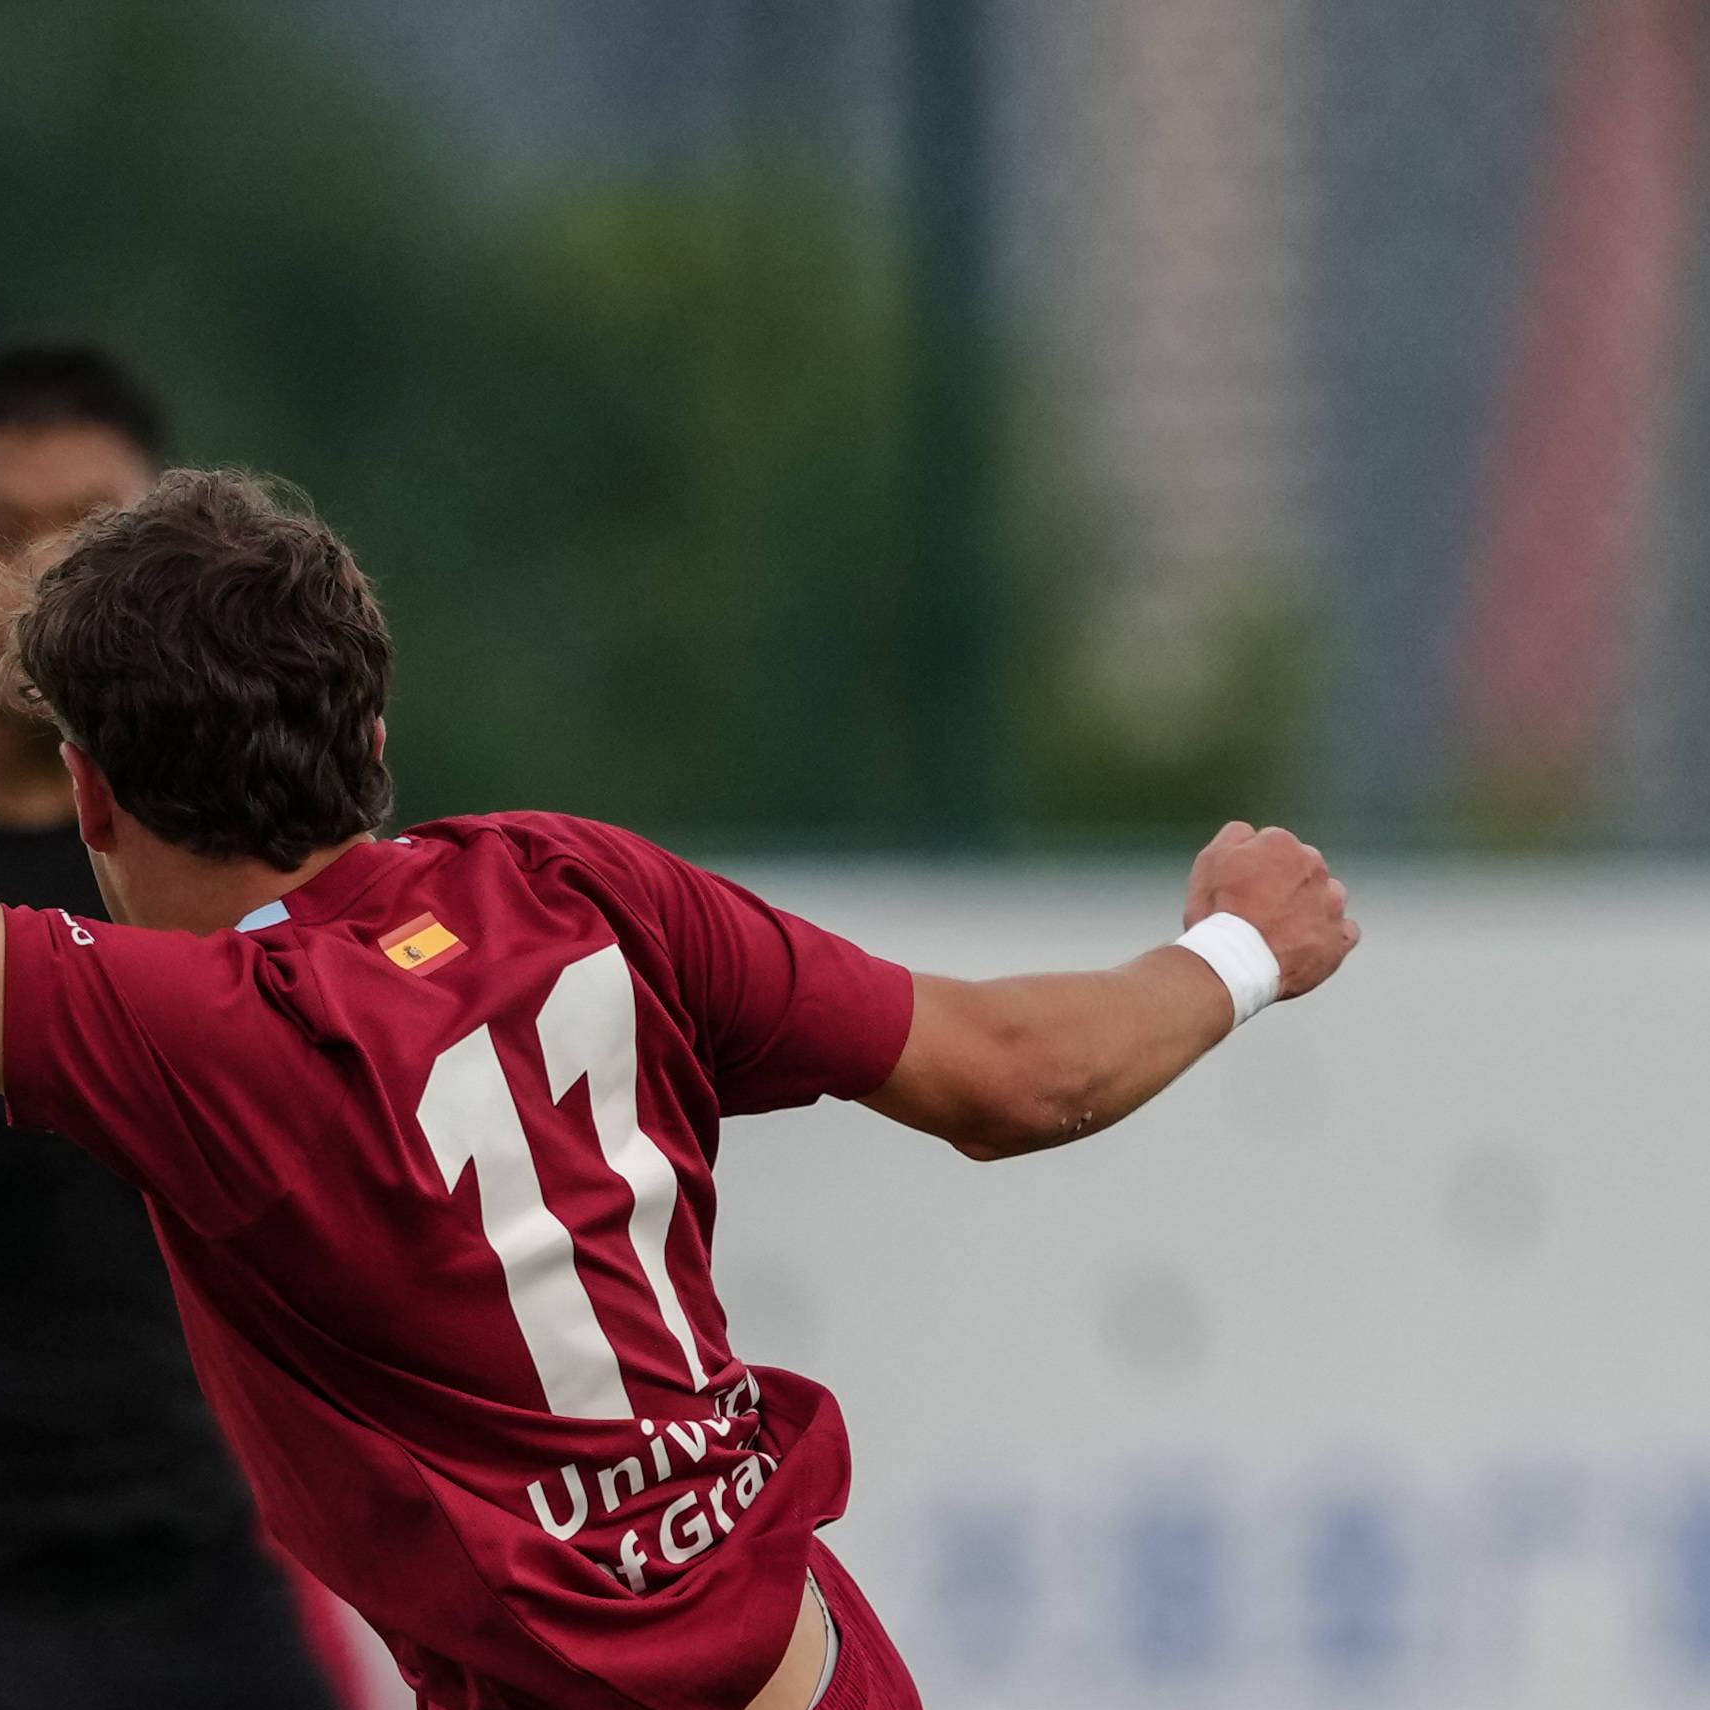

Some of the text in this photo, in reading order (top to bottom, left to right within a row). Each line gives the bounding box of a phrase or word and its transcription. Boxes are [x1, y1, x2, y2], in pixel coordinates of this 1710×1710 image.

[416, 943, 709, 1420] 11
[526, 1368, 762, 1542] Univ
[596, 1452, 779, 1594] f Gra
